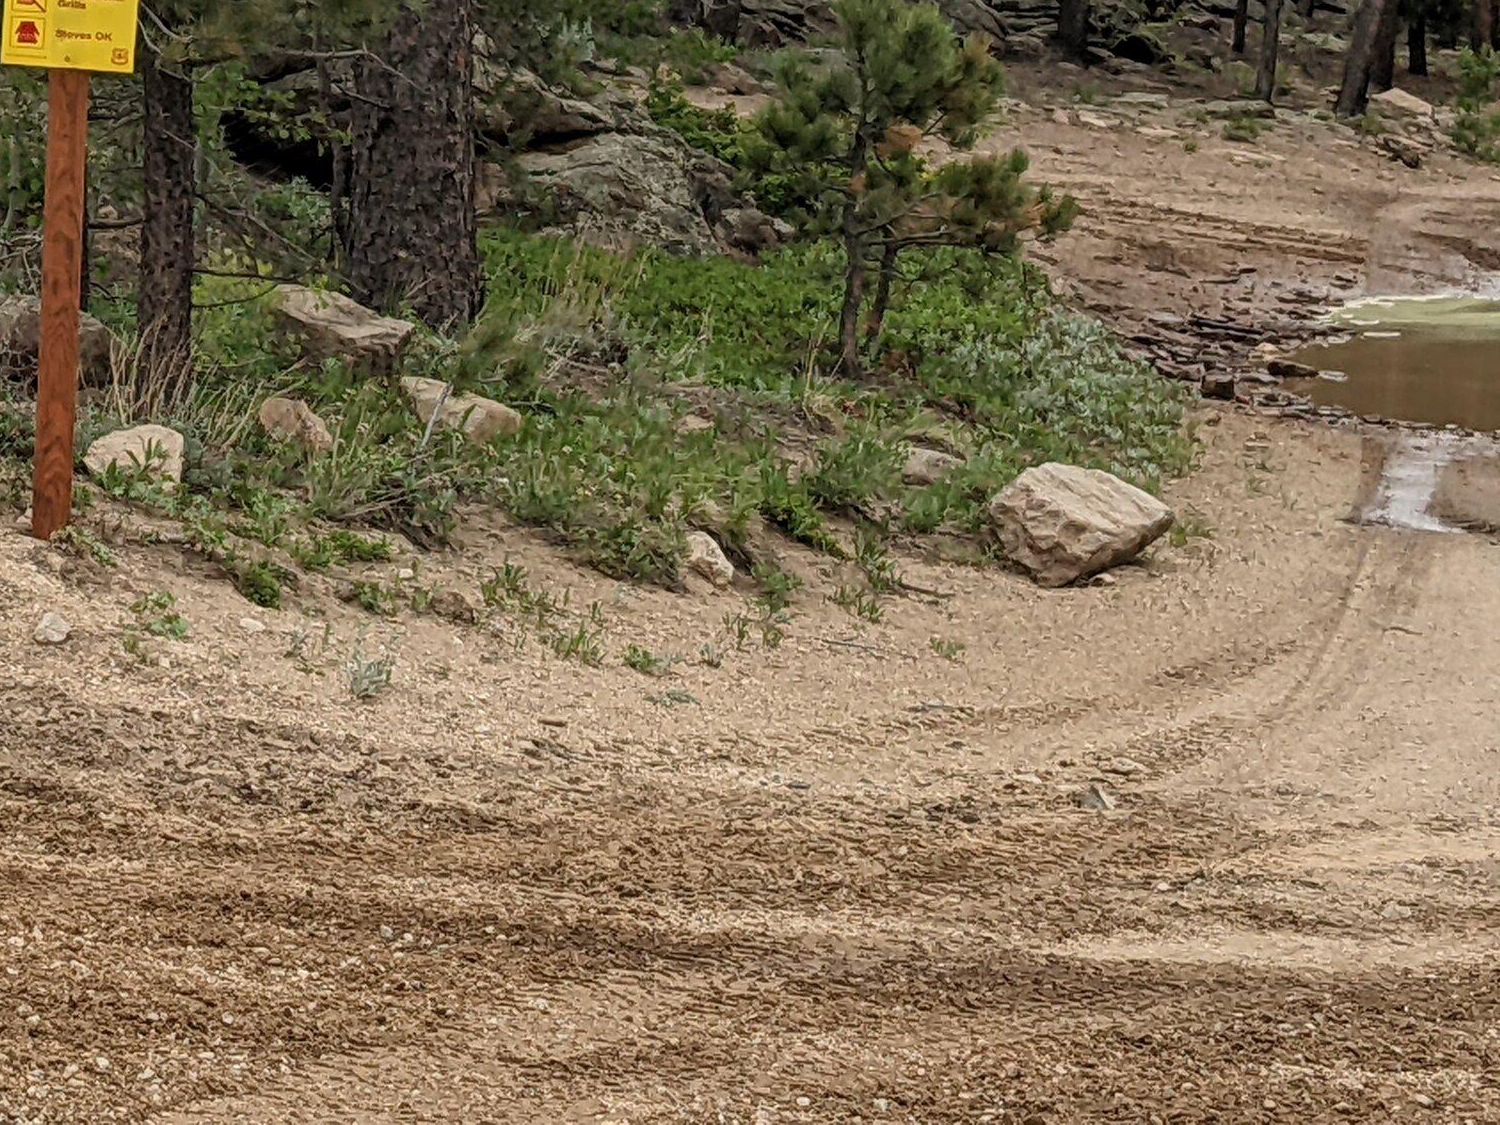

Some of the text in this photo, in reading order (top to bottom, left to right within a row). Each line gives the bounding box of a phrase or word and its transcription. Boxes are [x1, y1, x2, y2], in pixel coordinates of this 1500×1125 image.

[57, 0, 87, 10] Grills
[55, 29, 113, 41] Stoves OK
